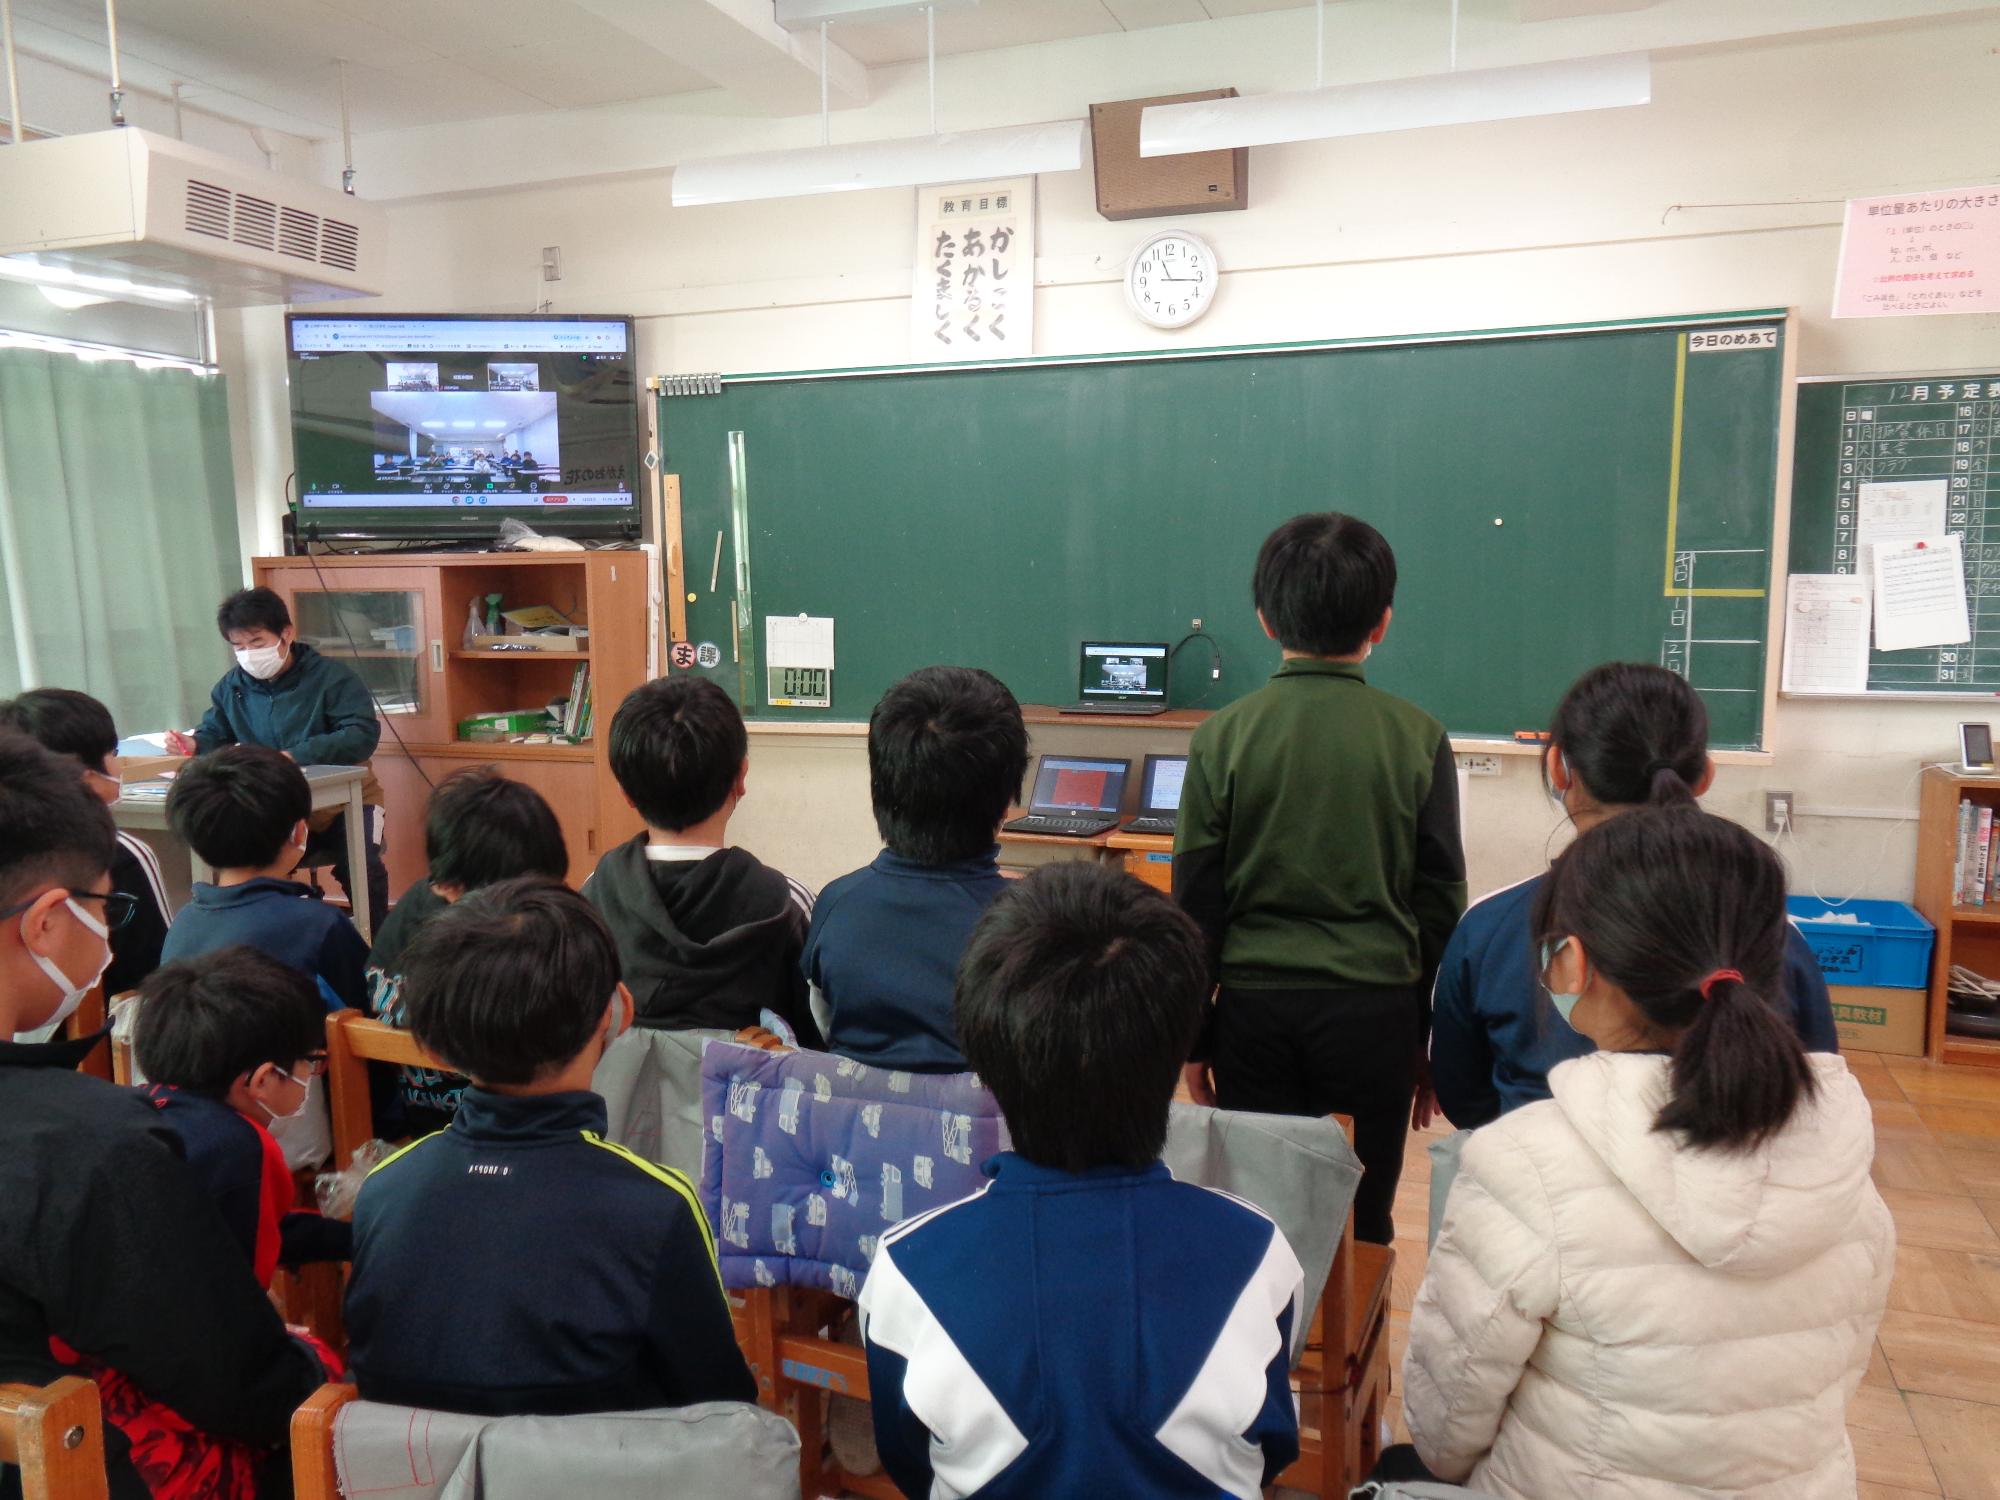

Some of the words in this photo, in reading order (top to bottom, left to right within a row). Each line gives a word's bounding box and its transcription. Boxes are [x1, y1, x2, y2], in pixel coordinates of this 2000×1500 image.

[943, 196, 1008, 213] 教育目標
[1868, 193, 2000, 216] 単位量あたりの大きさ
[1152, 248, 1160, 261] 11
[1165, 243, 1175, 256] 12
[1141, 261, 1152, 273] 10
[1191, 256, 1198, 268] 2
[1139, 277, 1147, 289] 9
[1197, 270, 1203, 284] 3
[934, 230, 957, 345] たくましく
[962, 227, 985, 342] あかるく
[1144, 291, 1151, 303] 8
[1192, 286, 1200, 298] 4
[1154, 301, 1161, 313] 7
[1168, 304, 1176, 316] 6
[1183, 299, 1190, 311] 5
[1691, 331, 1776, 348] 今日のめあて
[1846, 411, 1856, 421] 日
[1958, 406, 1972, 417] 16
[1847, 428, 1852, 439] 1
[1958, 424, 1971, 434] 17
[1844, 446, 1854, 456] 2
[1957, 442, 1970, 452] 18
[1843, 463, 1853, 473] 3
[1956, 459, 1968, 470] 19
[1842, 481, 1851, 491] 4
[1953, 477, 1968, 488] 20
[1841, 498, 1850, 508] 5
[1952, 495, 1966, 505] 21
[1840, 515, 1849, 525] 6
[1952, 513, 1966, 524] 22
[1840, 533, 1849, 542] 7
[1838, 550, 1848, 560] 8
[676, 646, 693, 665] ま
[700, 646, 716, 663] 課
[1940, 652, 1957, 663] 30
[1941, 669, 1955, 679] 31
[784, 668, 826, 697] 0:00
